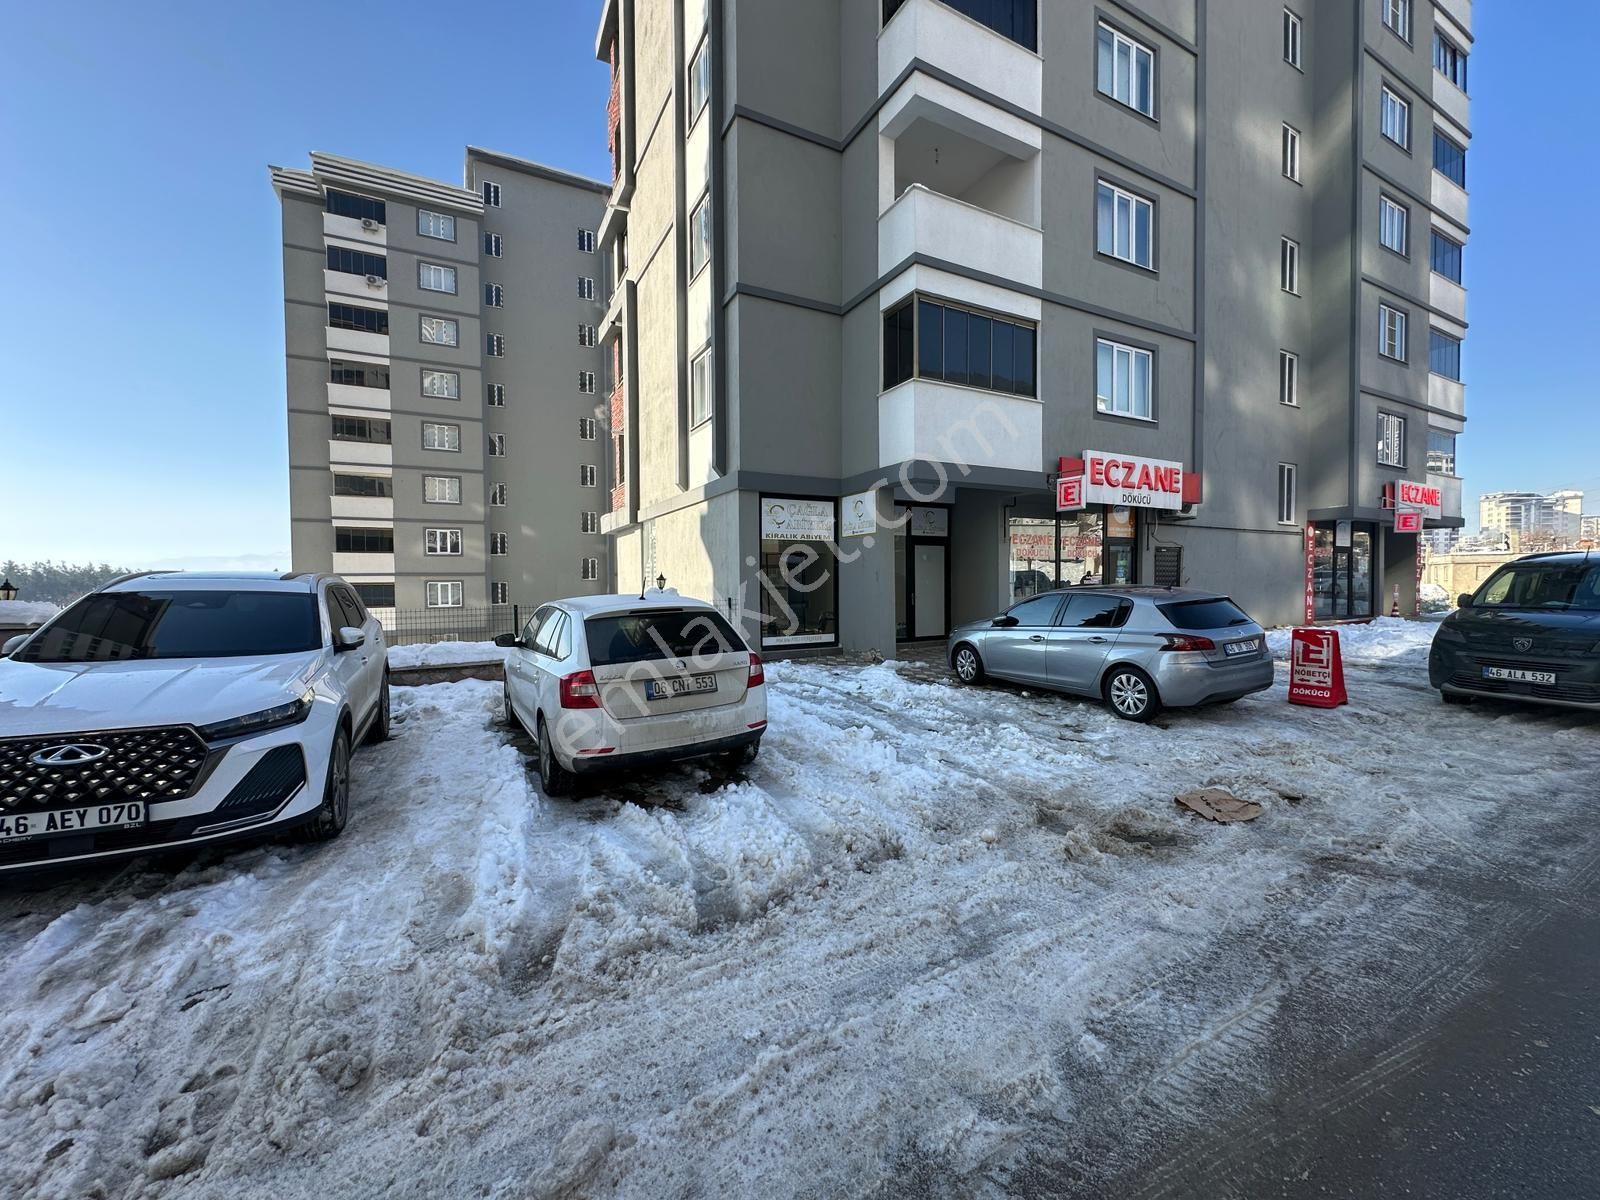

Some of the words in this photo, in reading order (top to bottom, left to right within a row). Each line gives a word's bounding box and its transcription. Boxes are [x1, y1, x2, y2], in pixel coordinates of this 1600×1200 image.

[1089, 457, 1181, 494] ECZANE
[1064, 485, 1076, 503] E
[1122, 492, 1152, 505] DÖKÜCÜ
[1401, 484, 1441, 507] ECZANE
[1402, 516, 1414, 528] E
[1012, 533, 1053, 546] ECZANE
[1062, 535, 1101, 547] ECZANE
[1306, 540, 1315, 620] ECZANE
[1489, 667, 1503, 678] 46
[1507, 670, 1527, 681] ALA
[1531, 672, 1553, 683] 532
[653, 680, 668, 695] 06
[695, 676, 714, 690] 553
[1292, 687, 1331, 698] DÖKÜCÜ
[0, 815, 29, 837] 46
[45, 808, 89, 832] AEY
[98, 803, 141, 825] 070
